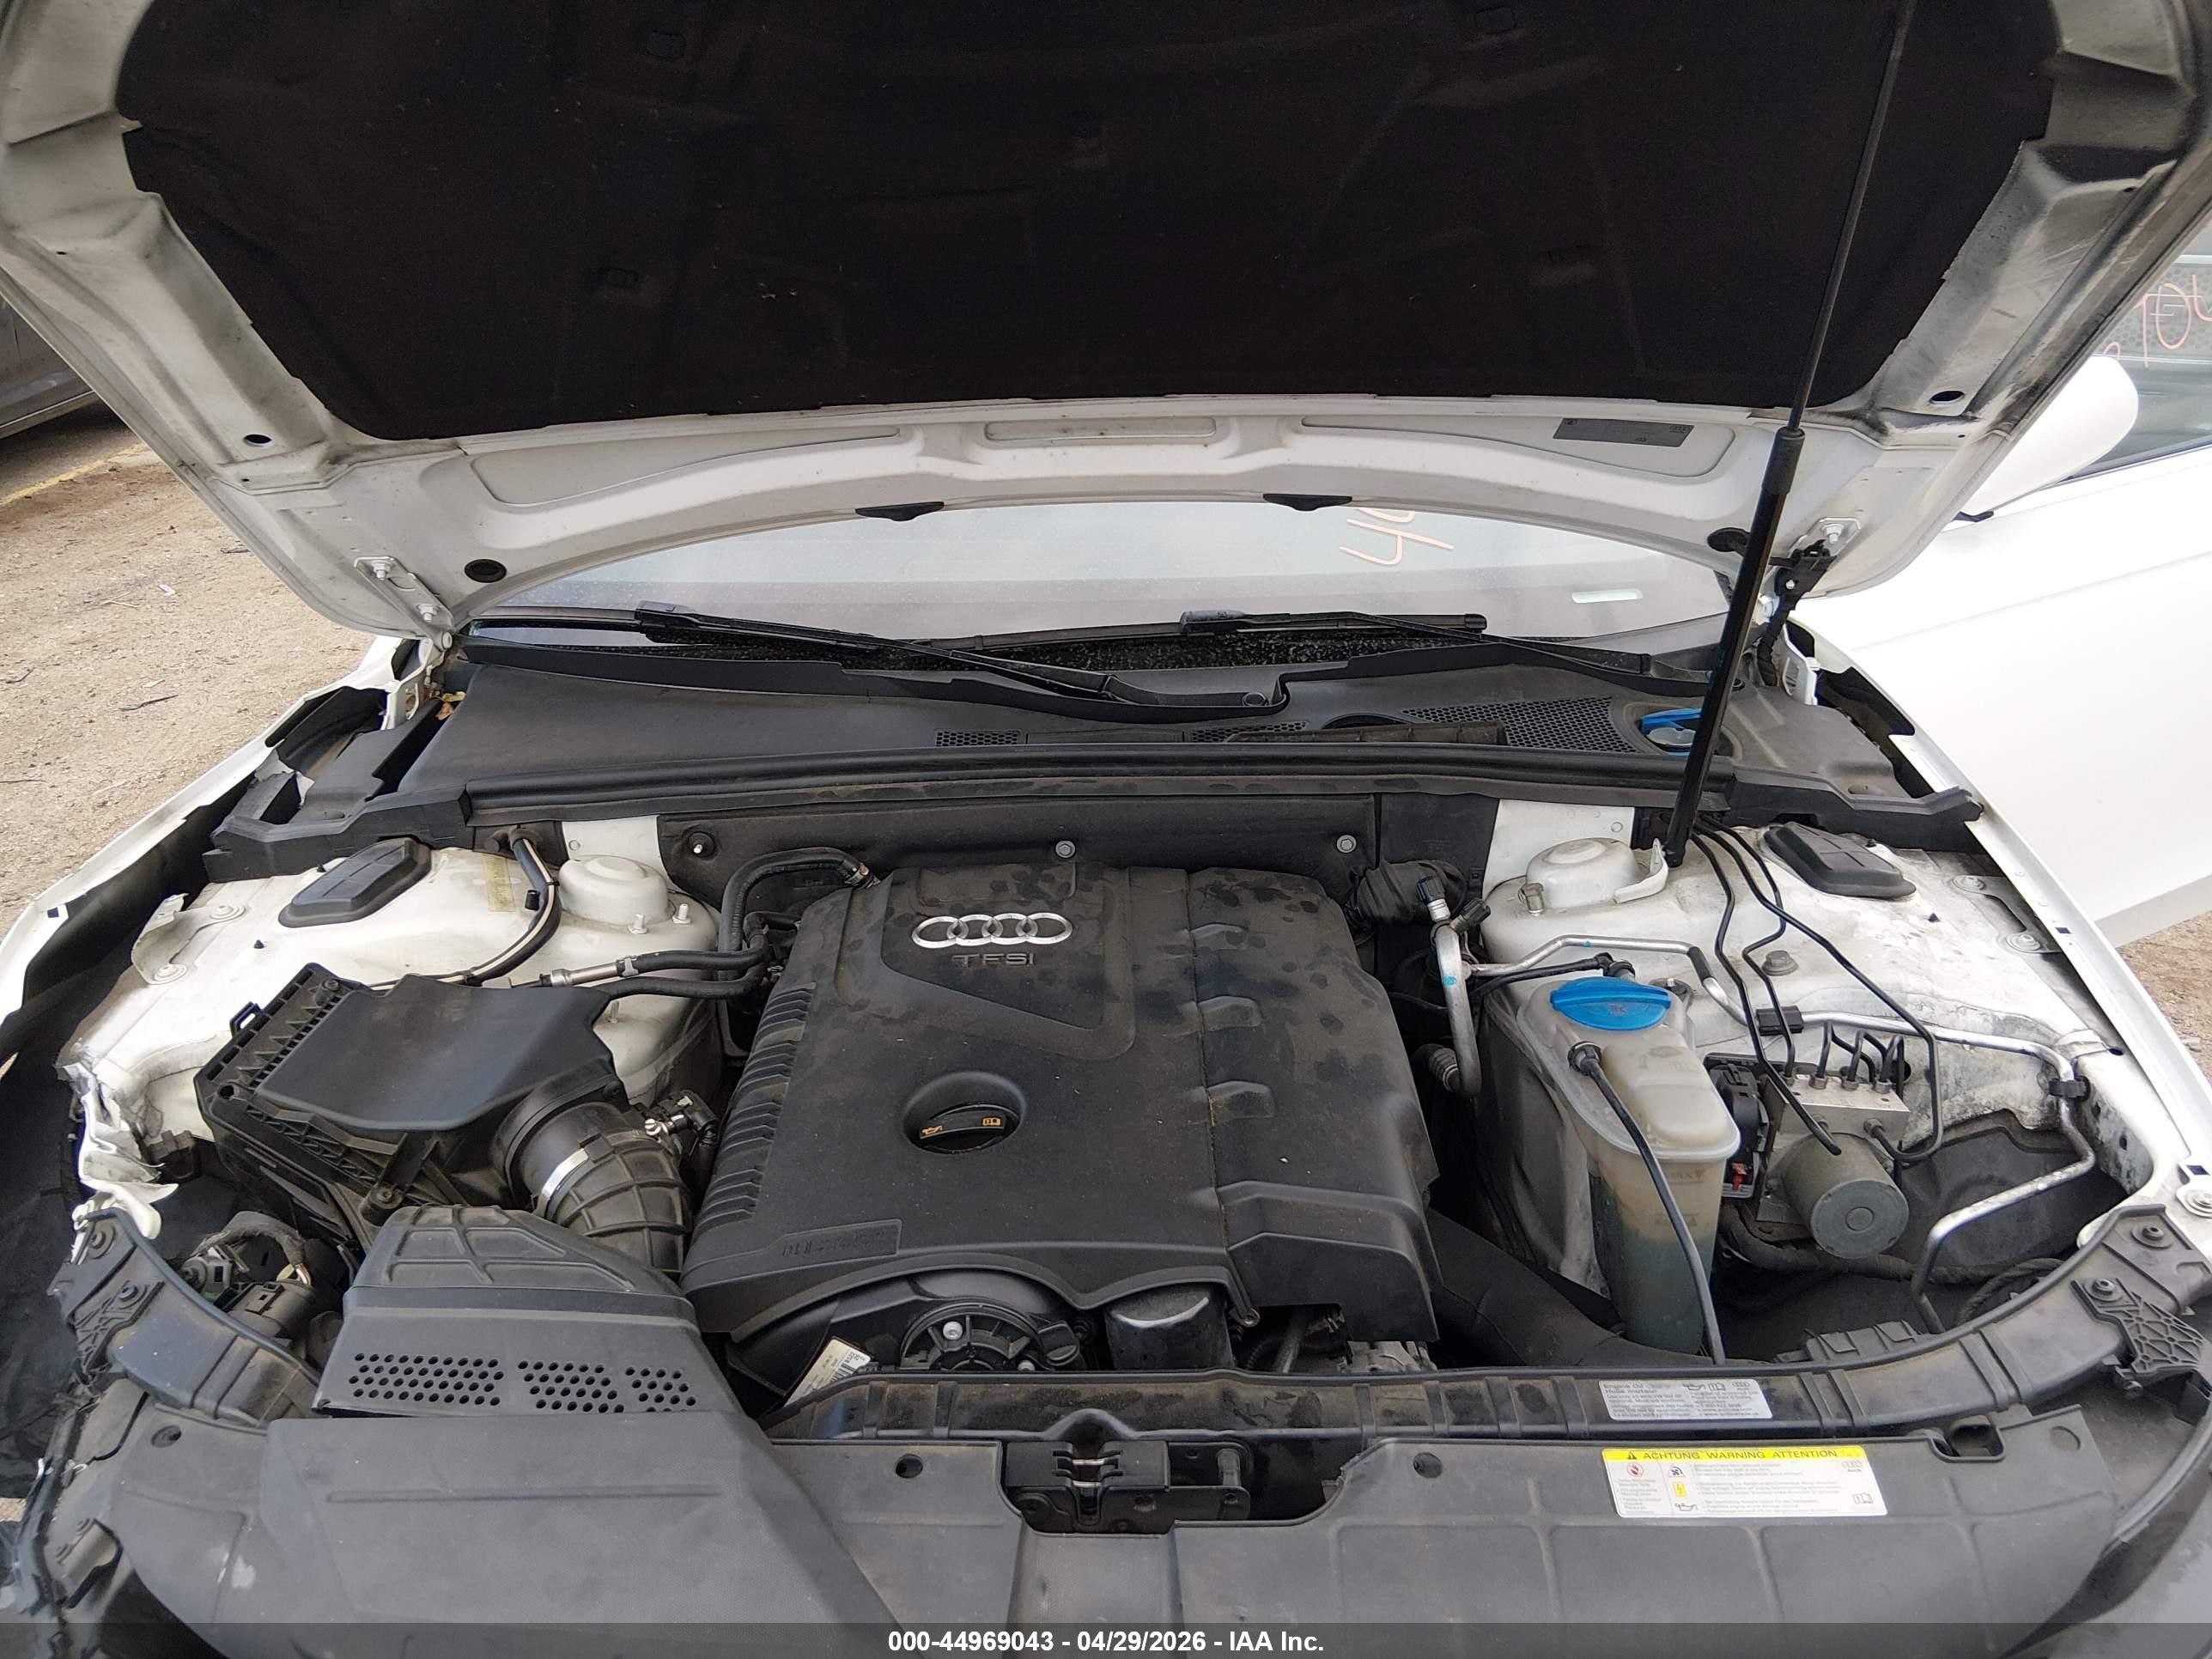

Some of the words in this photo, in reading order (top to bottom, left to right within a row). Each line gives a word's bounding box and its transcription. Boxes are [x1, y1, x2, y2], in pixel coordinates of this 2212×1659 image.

[951, 952, 1035, 968] TFSI
[1643, 1452, 1700, 1461] ACHTUNG
[1707, 1451, 1765, 1460] WARNING
[1772, 1449, 1838, 1458] ATTENTION
